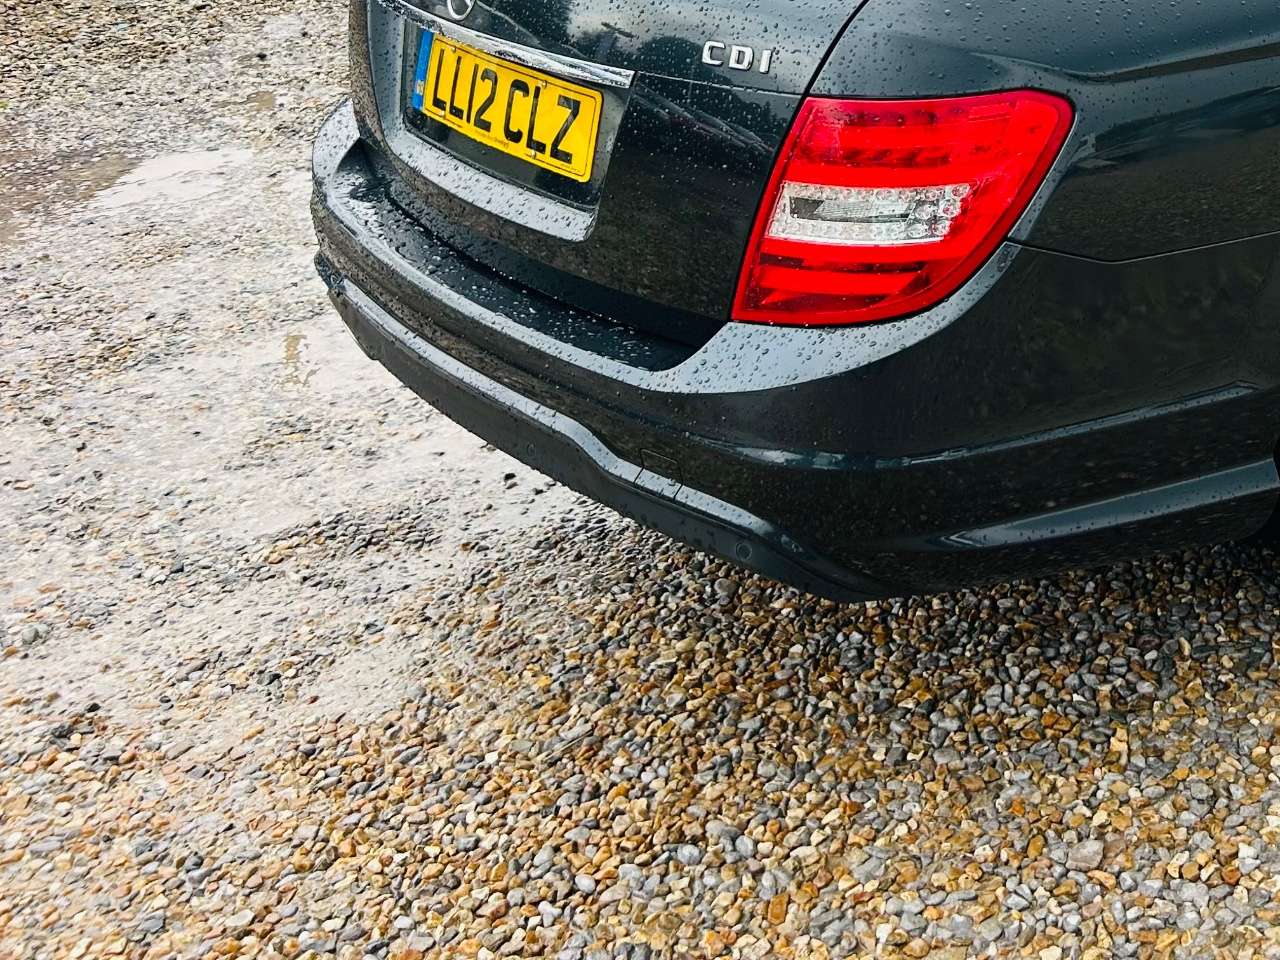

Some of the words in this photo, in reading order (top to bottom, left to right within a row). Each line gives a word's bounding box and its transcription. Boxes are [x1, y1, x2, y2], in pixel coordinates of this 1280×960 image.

[702, 40, 773, 74] CDI
[432, 48, 499, 133] LL12
[503, 78, 581, 165] CLZ
